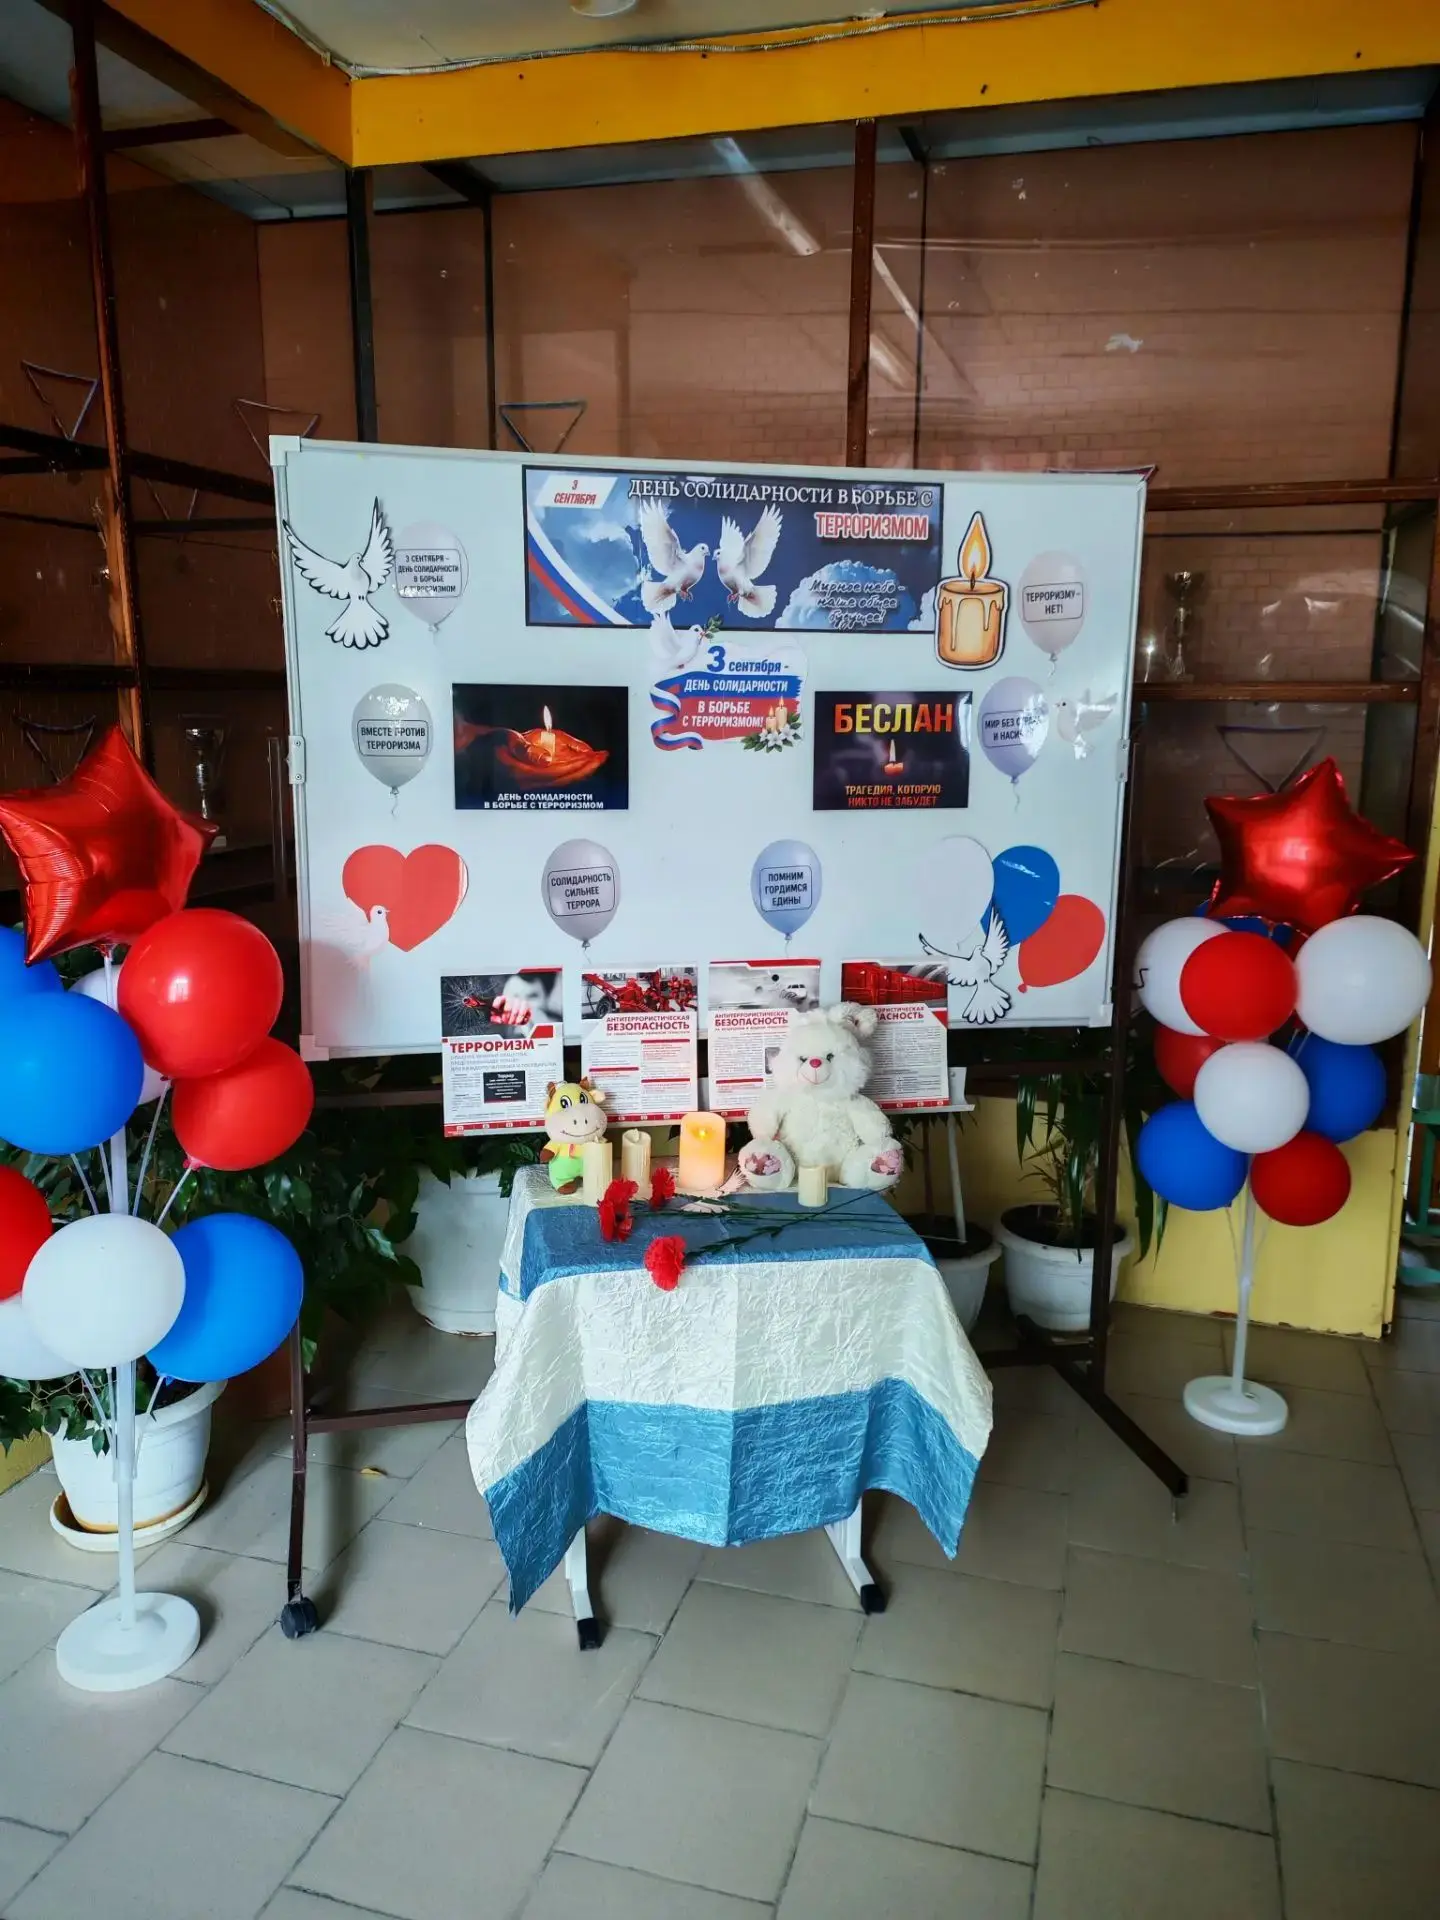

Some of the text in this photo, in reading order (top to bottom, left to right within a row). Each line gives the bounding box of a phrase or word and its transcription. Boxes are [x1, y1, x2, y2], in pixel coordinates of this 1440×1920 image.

[572, 480, 578, 490] 3
[554, 493, 596, 504] СЕНТЯБРЯ
[629, 479, 932, 507] ДЕНЬ СОЛИДАРНОСТИ В БОРЬБЕ С
[815, 512, 928, 540] ТЕРРОРИЗМОМ
[398, 565, 459, 574] ДЕНЬ СОЛИДАРНОСТИ
[809, 580, 861, 597] Мирное
[863, 579, 896, 593] небо
[817, 595, 897, 610] наше общее
[1045, 604, 1063, 614] НЕТ!
[829, 609, 886, 629] будущее!
[707, 645, 726, 672] 3
[729, 659, 781, 674] сентября
[684, 679, 788, 693] ДЕНЬ СОЛИДАРНОСТИ
[698, 701, 750, 714] В БОРЬБЕ
[682, 716, 764, 727] С ТЕРРОРИЗМОМ!
[834, 703, 953, 733] БЕСЛАН
[985, 719, 999, 729] МИР
[1002, 718, 1014, 727] БЕЗ
[361, 727, 392, 736] ВМЕСТЕ
[993, 732, 998, 741] И
[367, 740, 420, 750] ТЕРРОРИЗМА
[845, 784, 942, 796] ТРАГЕДИЯ, КОТОРУЮ
[523, 793, 593, 802] СОЛИДАРНОСТИ
[848, 796, 936, 807] НИКТО НЕ ЗАБУДЕТ
[551, 873, 611, 886] СОЛИДАРНОСТЬ
[768, 872, 803, 881] ПОМНИМ
[565, 886, 599, 897] СИЛЬНЕЕ
[765, 883, 808, 895] ГОРДИМСЯ
[566, 898, 600, 910] ТЕРРОРА
[772, 896, 801, 906] ЕДИНЫ
[606, 1021, 690, 1031] БЕЗОПАСНОСТЬ
[715, 1017, 788, 1027] БЕЗОПАСНОСТЬ
[450, 1040, 535, 1053] ТЕРРОРИЗМ
